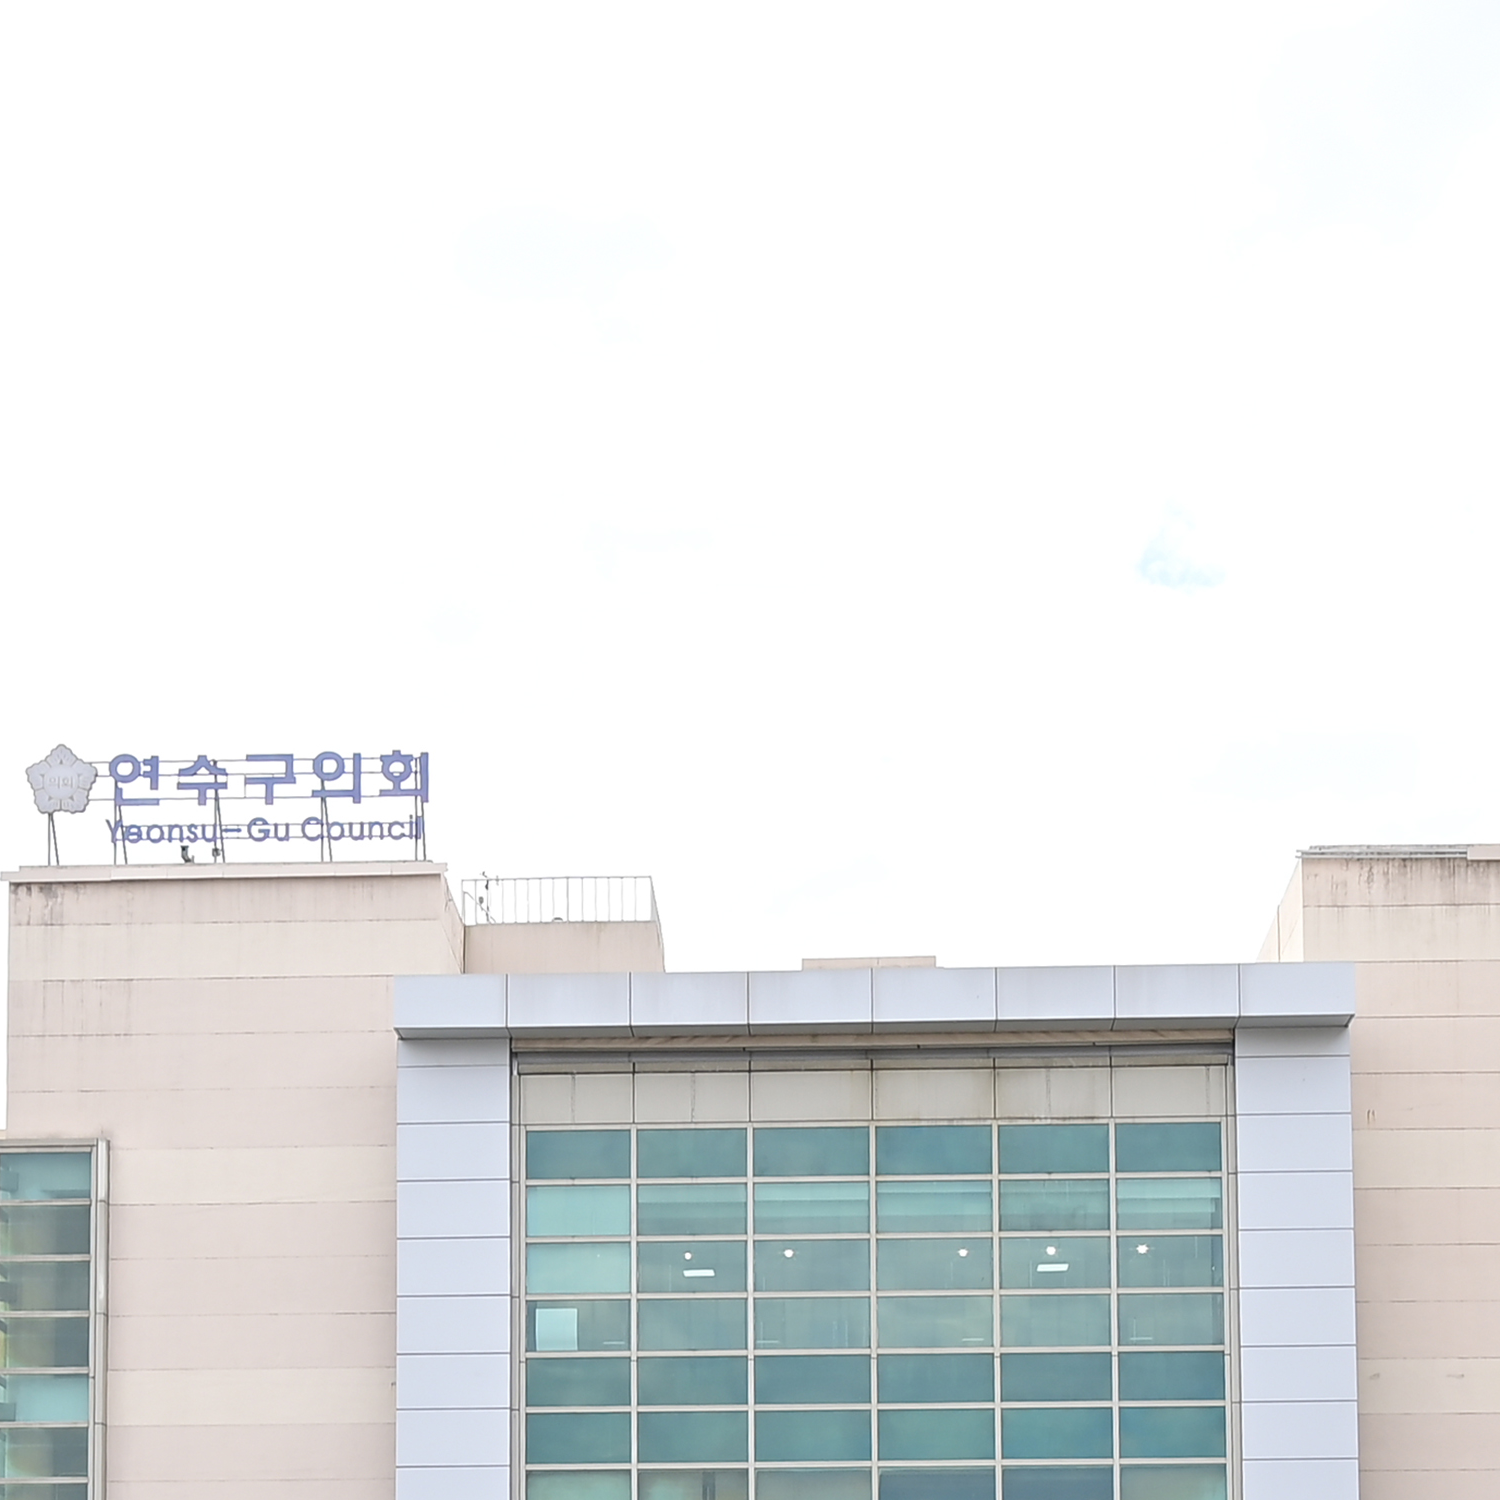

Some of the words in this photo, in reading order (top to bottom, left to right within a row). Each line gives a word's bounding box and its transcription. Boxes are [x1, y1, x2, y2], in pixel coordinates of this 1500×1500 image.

[108, 750, 429, 806] 연수구의회
[105, 818, 290, 844] Yeonsu-Gu
[301, 815, 422, 842] Council
